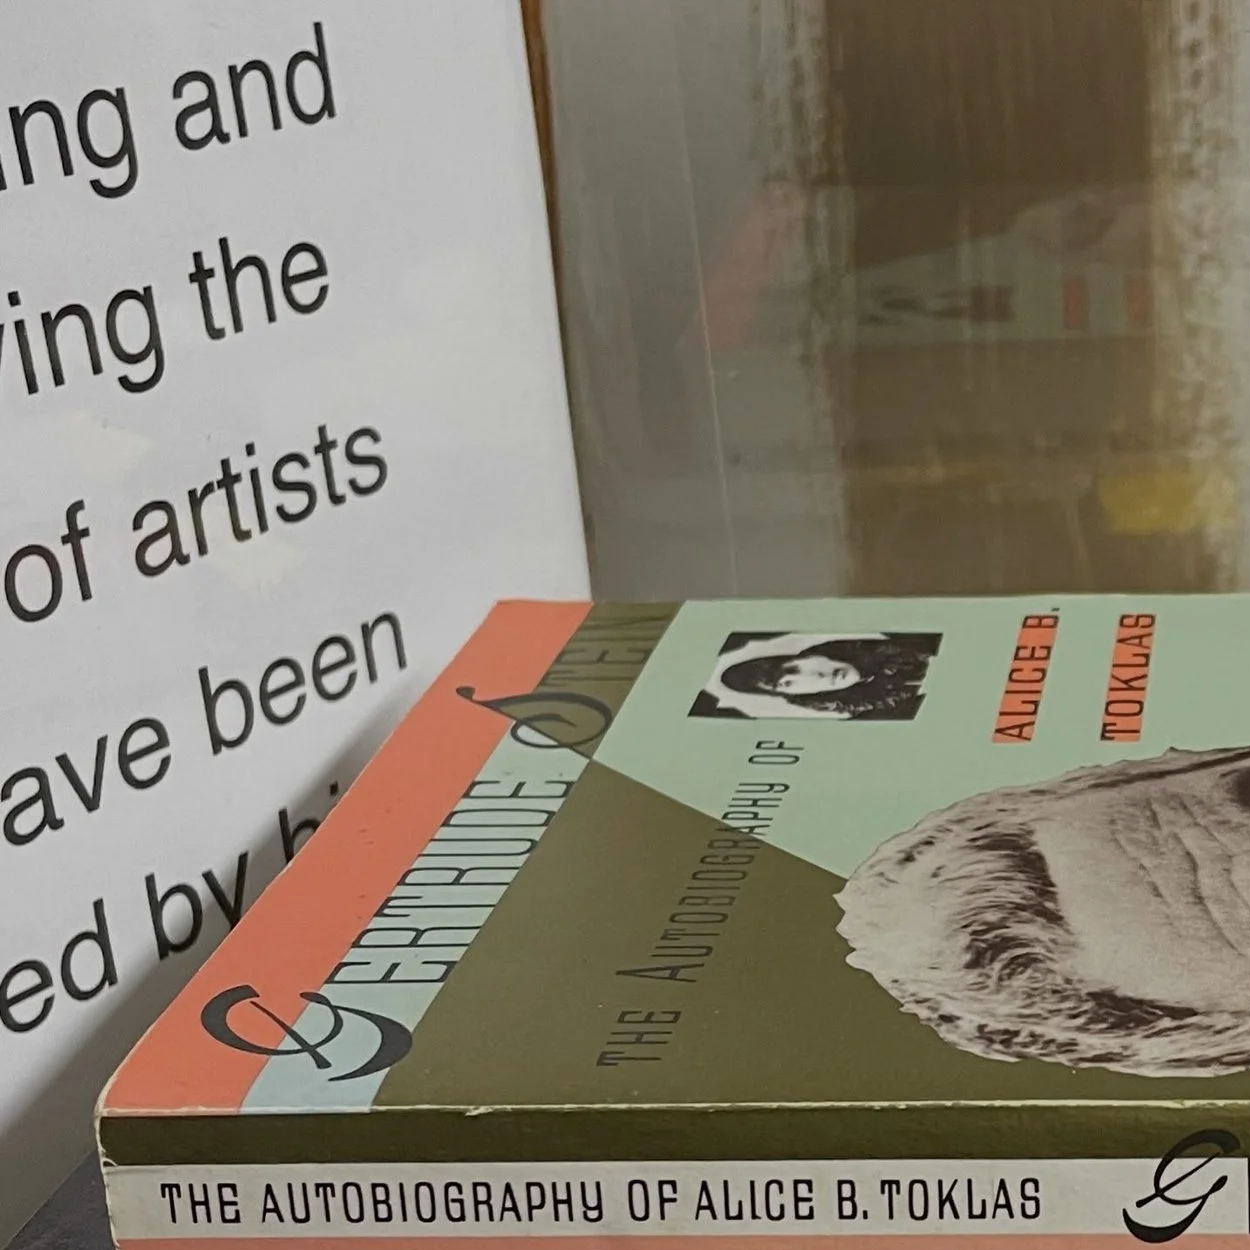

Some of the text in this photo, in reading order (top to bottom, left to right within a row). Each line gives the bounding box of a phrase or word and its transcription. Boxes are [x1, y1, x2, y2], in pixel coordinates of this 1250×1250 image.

[0, 22, 336, 198] ng and
[0, 237, 329, 393] ing the
[4, 424, 388, 622] of artists
[199, 612, 407, 756] been
[995, 607, 1060, 741] ALICE B.
[1100, 614, 1156, 741] TOKLAS
[0, 898, 118, 1032] ed
[596, 740, 804, 1066] THE AUTOBIOGRAPHY OF
[161, 1176, 1042, 1225] THE AUTOBIOGRAPHY OF ALICE B. TOKLAS
